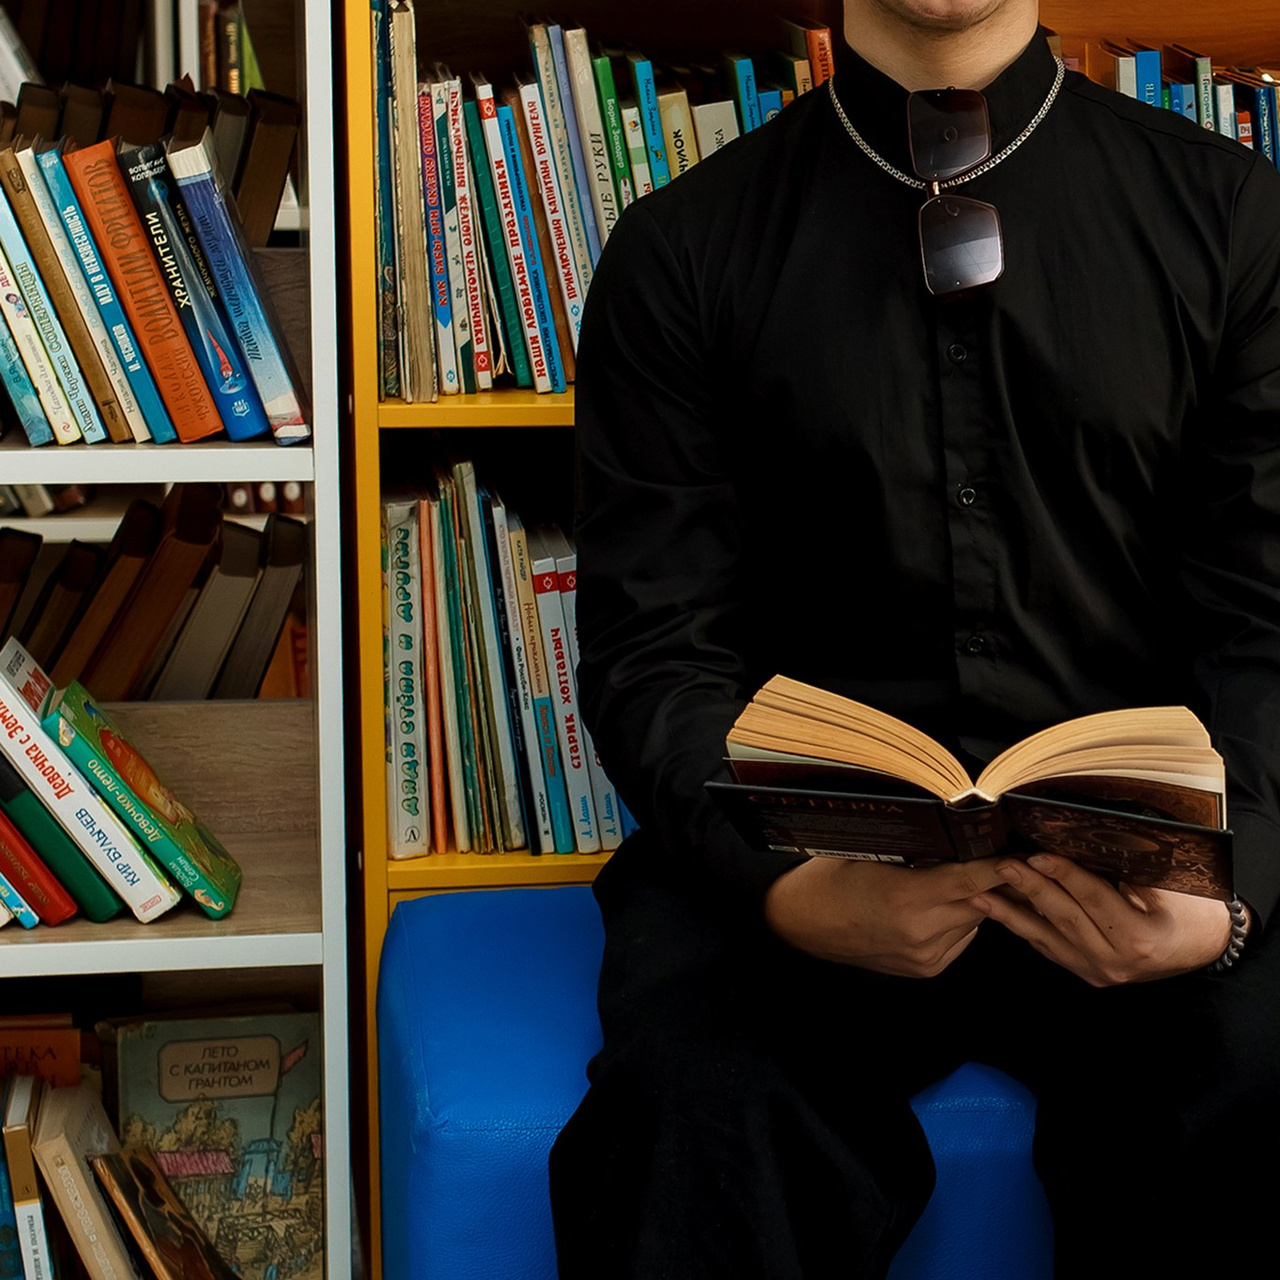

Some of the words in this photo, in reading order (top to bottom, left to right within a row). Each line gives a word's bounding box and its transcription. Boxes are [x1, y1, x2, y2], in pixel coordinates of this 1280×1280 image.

[146, 212, 191, 308] ХРАНИТЕЛИ
[23, 743, 74, 800] Девочка
[75, 808, 122, 863] БУЛЫЧЕВ
[118, 862, 140, 887] КИР
